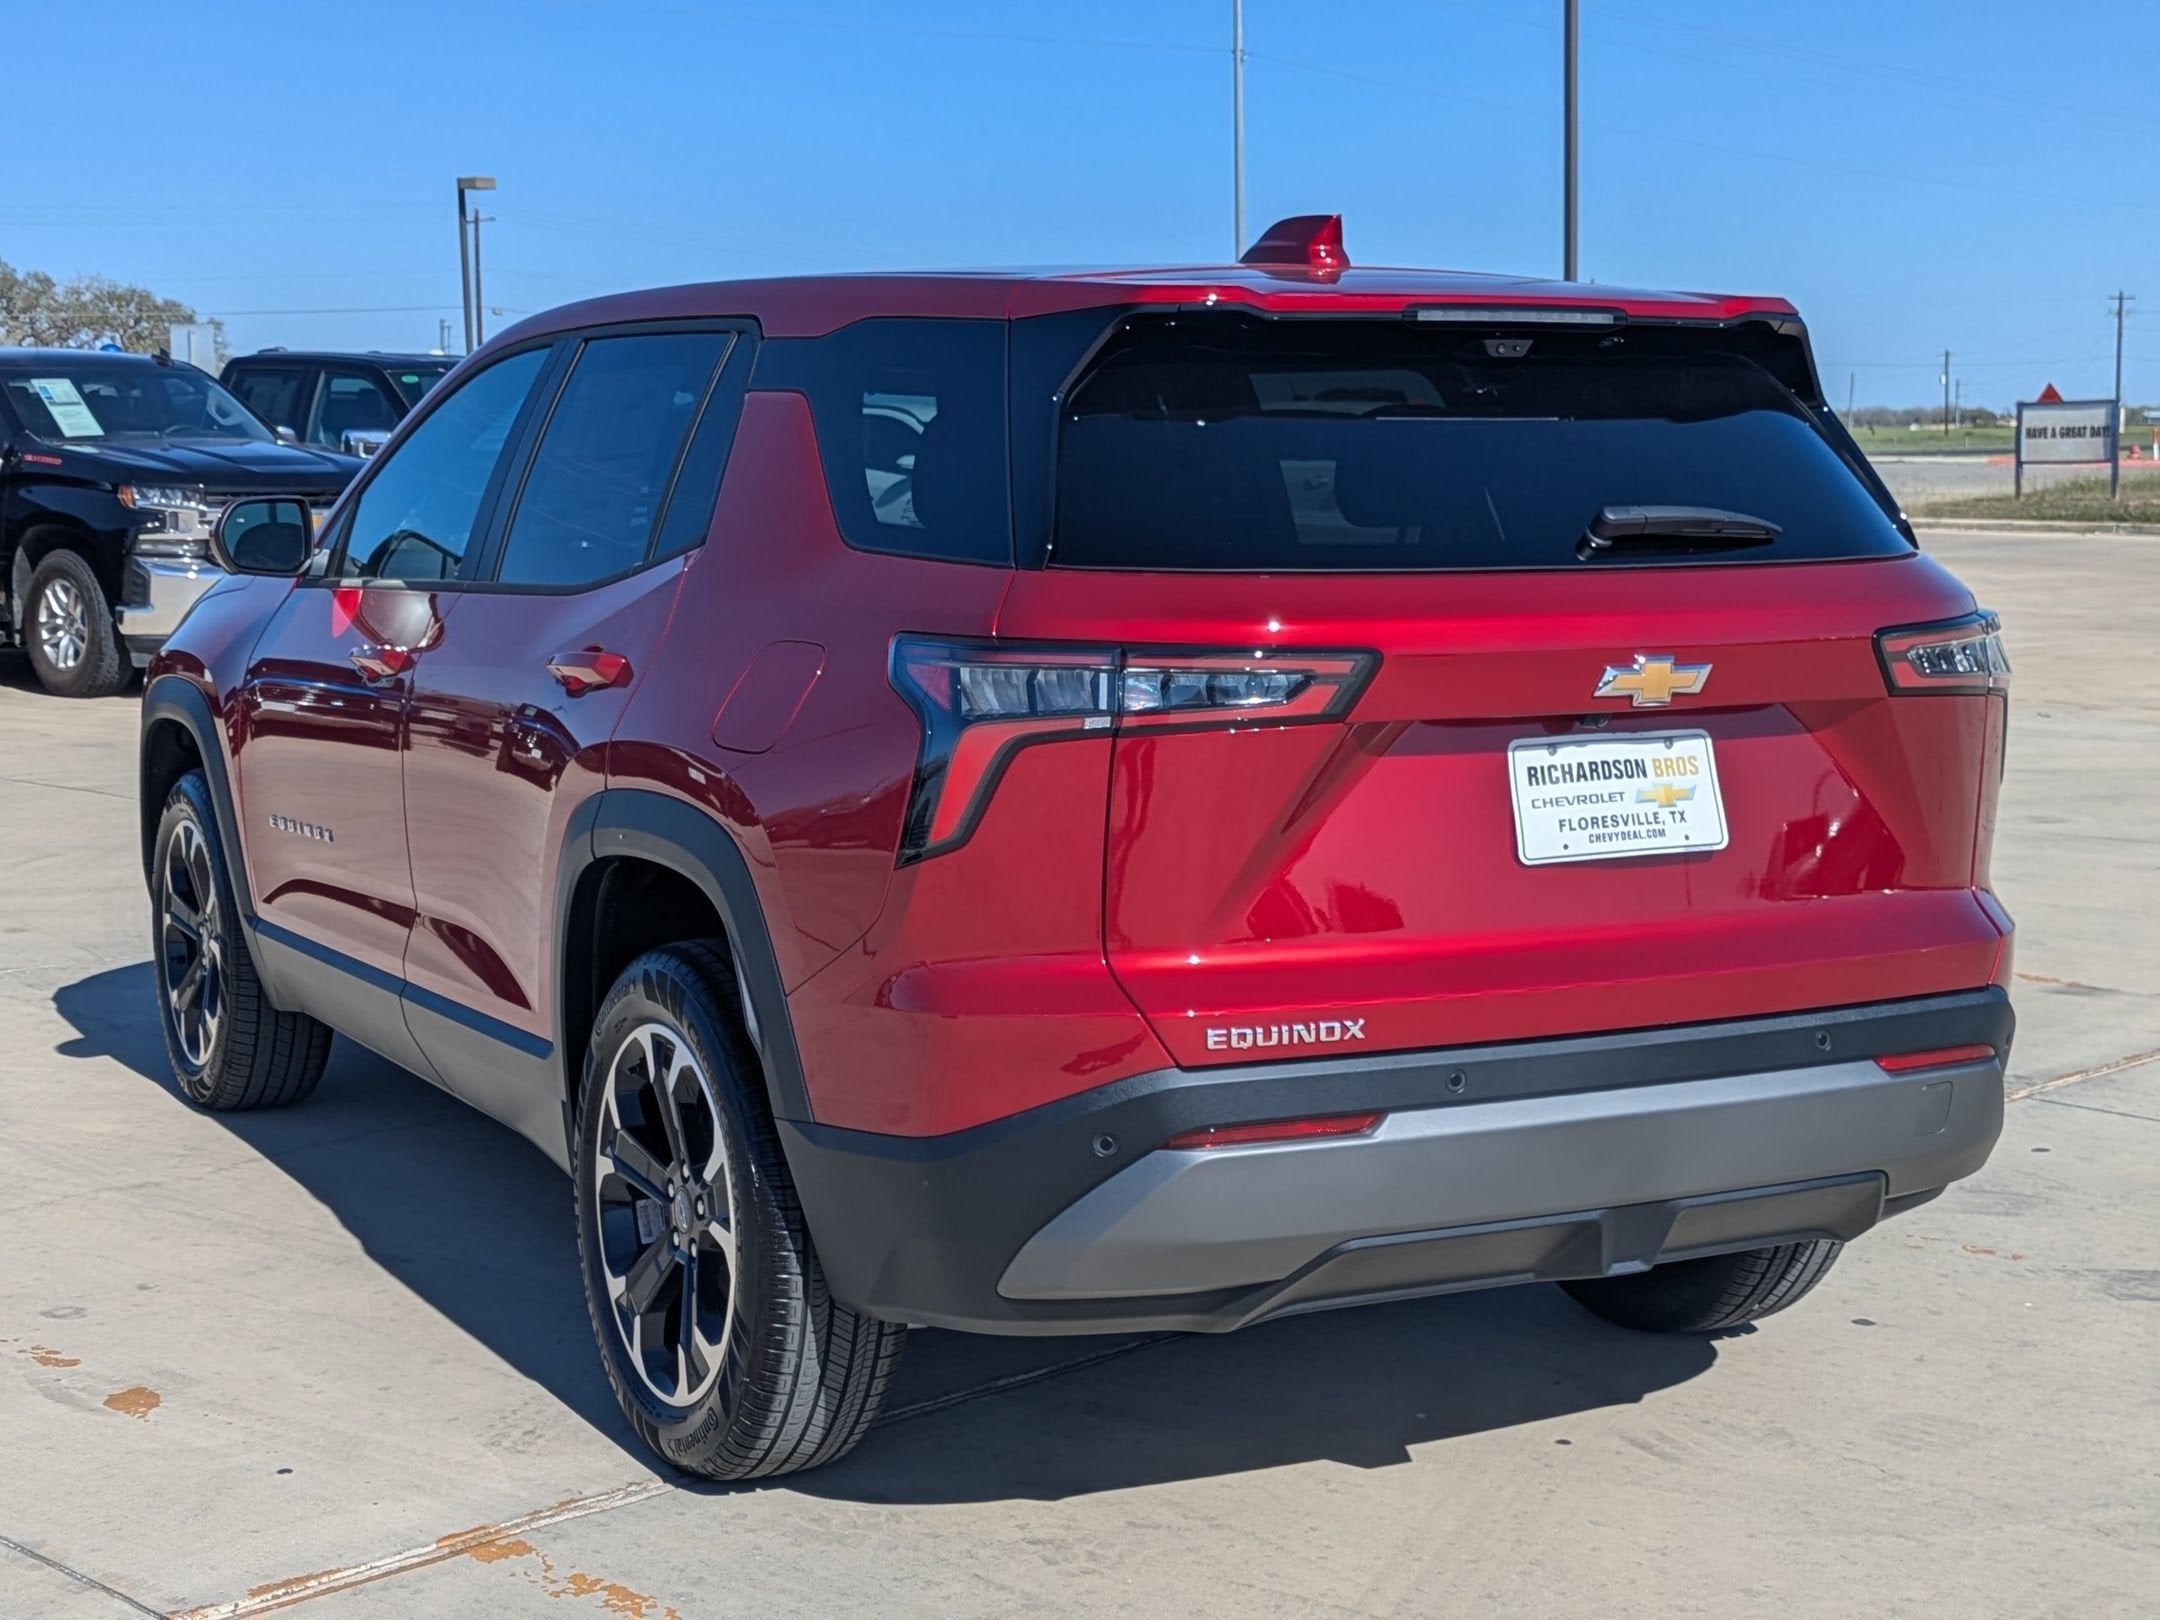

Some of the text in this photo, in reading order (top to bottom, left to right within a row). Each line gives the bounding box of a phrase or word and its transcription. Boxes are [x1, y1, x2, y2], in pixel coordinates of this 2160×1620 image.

[2025, 427, 2048, 439] HAVE
[2050, 427, 2057, 439] A
[2059, 426, 2087, 439] GREAT
[1527, 755, 1699, 787] RICHARDSON BROS
[1531, 791, 1626, 810] CHEVROLET
[1558, 810, 1688, 833] FLORESVILLE, TX
[1588, 828, 1667, 844] CHEVYDEAL.COM
[1206, 1018, 1366, 1050] EQUINOX
